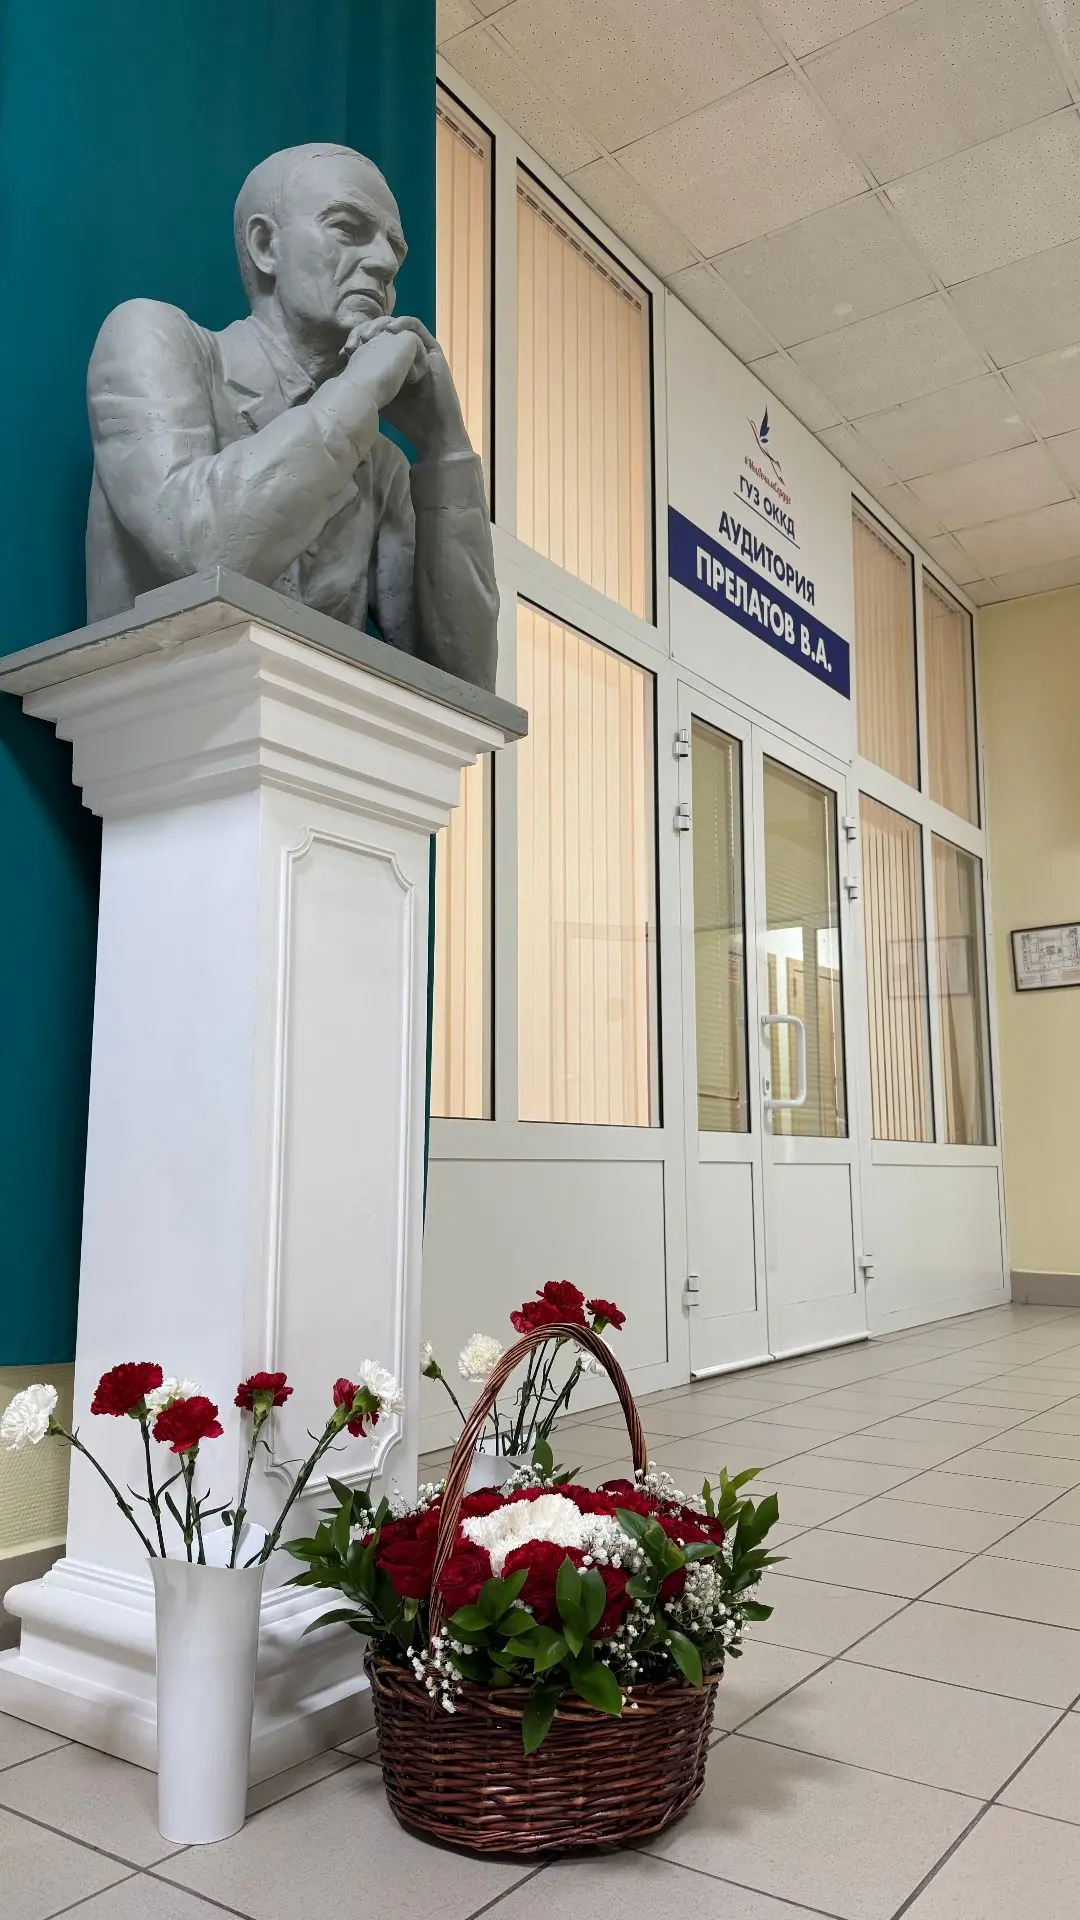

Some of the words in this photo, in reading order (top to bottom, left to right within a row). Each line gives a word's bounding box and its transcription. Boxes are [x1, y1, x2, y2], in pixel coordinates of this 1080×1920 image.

[739, 474, 760, 506] ГУЗ
[763, 497, 796, 540] ОККД
[718, 510, 815, 607] АУДИТОРИЯ
[696, 545, 795, 645] ПРЕЛАТОВ
[800, 623, 832, 673] В.А.
